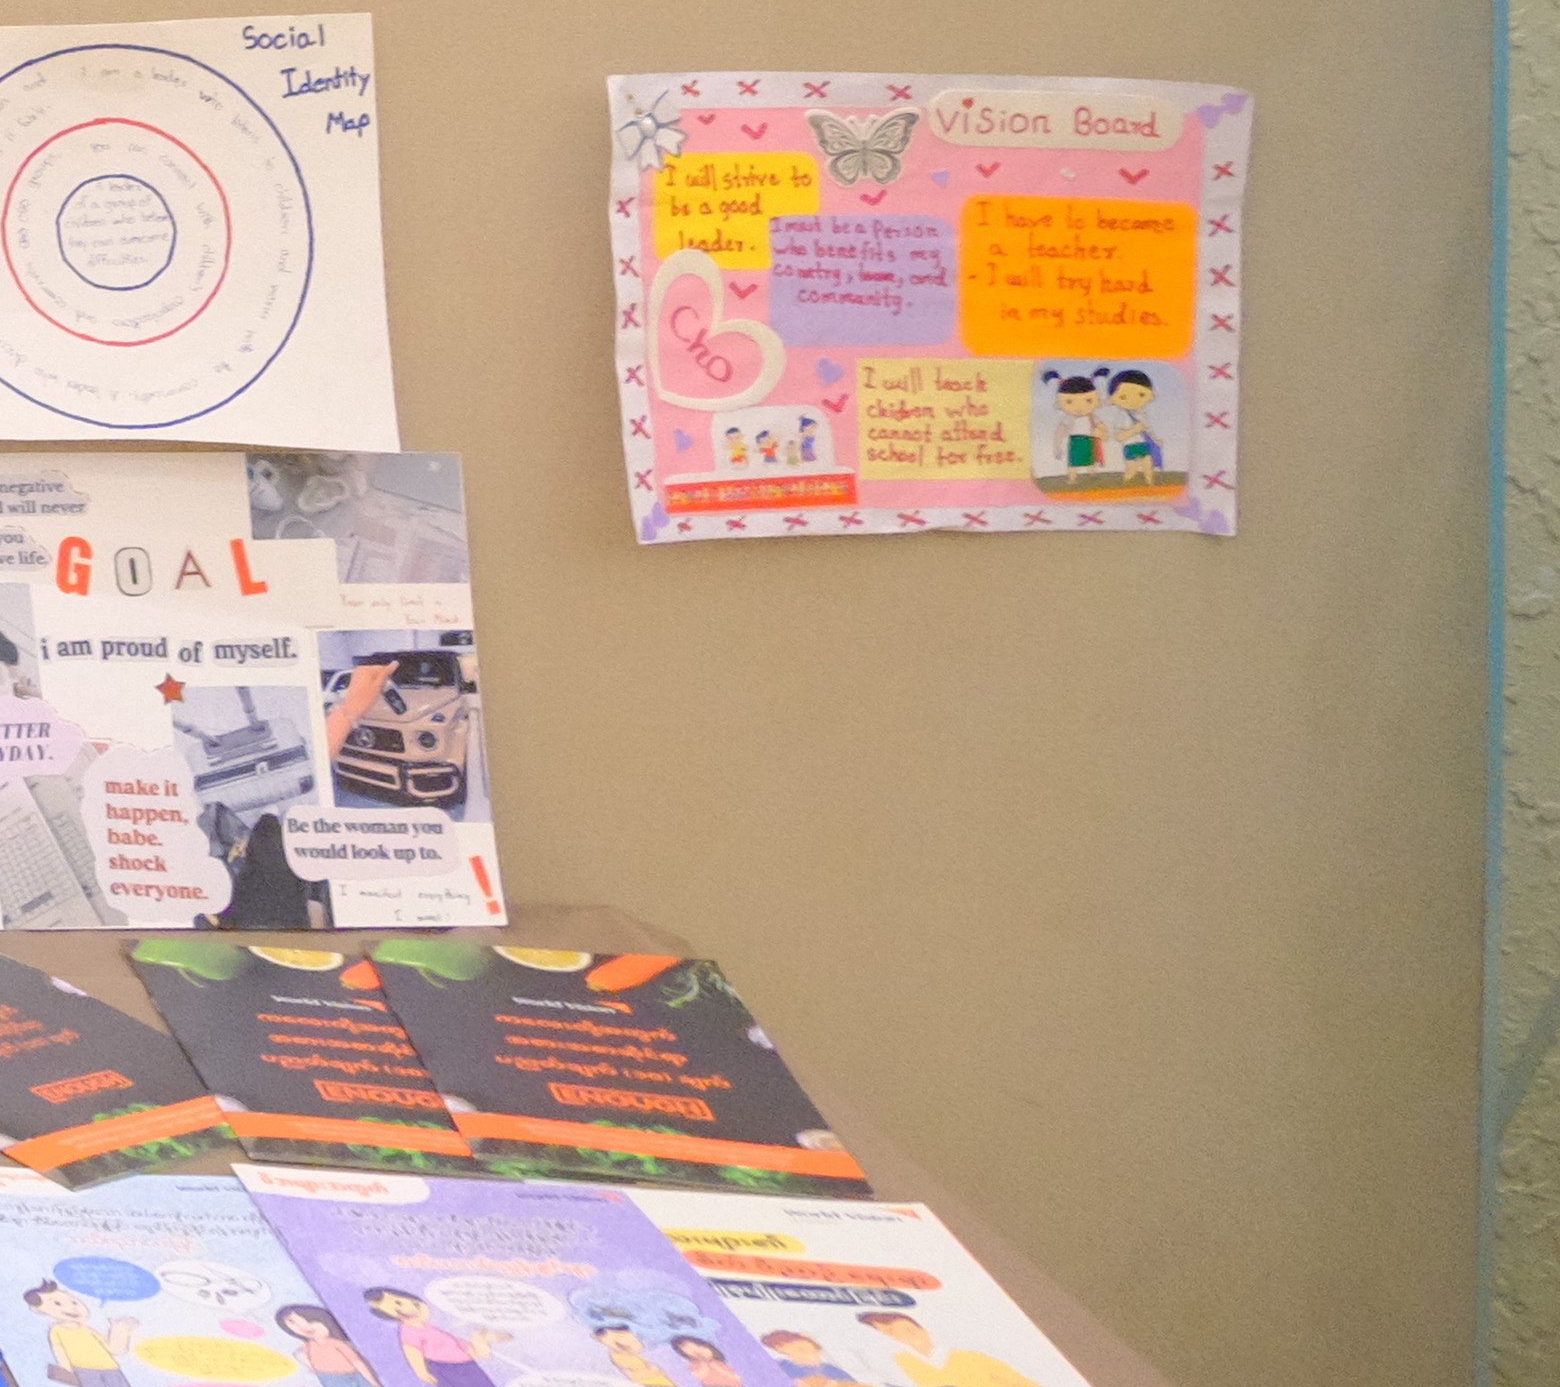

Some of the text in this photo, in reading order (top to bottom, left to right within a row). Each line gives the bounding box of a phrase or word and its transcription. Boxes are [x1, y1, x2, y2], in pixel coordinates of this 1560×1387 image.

[242, 23, 326, 52] Social
[280, 67, 372, 99] Identity
[325, 111, 371, 138] Map
[1073, 105, 1161, 139] Board
[669, 304, 733, 384] Cho
[6, 500, 38, 515] will
[39, 502, 87, 515] never
[55, 535, 269, 597] GOAL
[56, 638, 93, 658] am
[100, 637, 168, 663] proud
[177, 640, 204, 663] of
[213, 636, 298, 665] myself.
[104, 779, 179, 798] make it
[104, 803, 189, 825] happen,
[106, 828, 163, 848] babe.
[286, 816, 444, 838] Be the woman you
[108, 854, 168, 873] shock
[293, 844, 442, 864] would look up to.
[109, 883, 209, 903] everyone.
